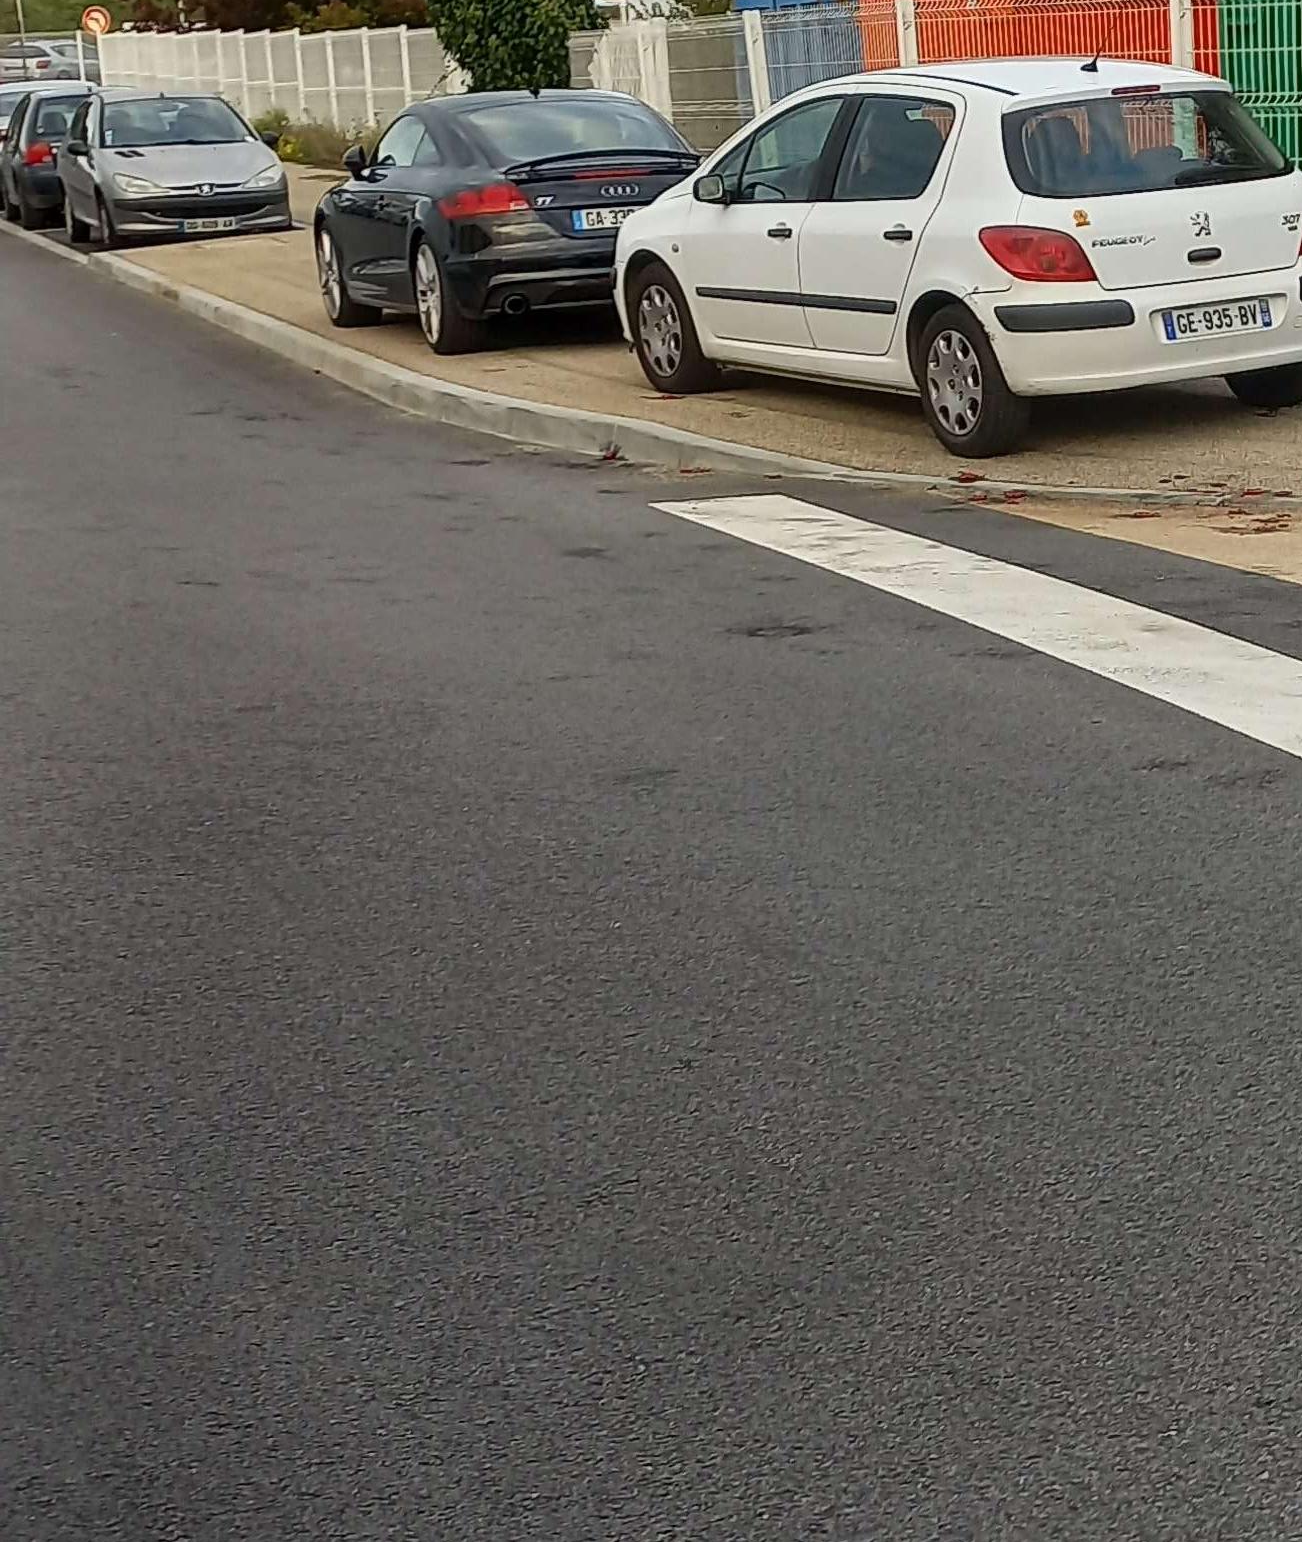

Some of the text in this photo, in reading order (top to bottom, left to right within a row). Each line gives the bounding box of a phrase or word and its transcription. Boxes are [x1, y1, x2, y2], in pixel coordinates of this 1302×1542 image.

[1281, 213, 1300, 226] 307
[1091, 234, 1144, 249] PEUGEOT
[1176, 303, 1258, 335] GE-935-BV
